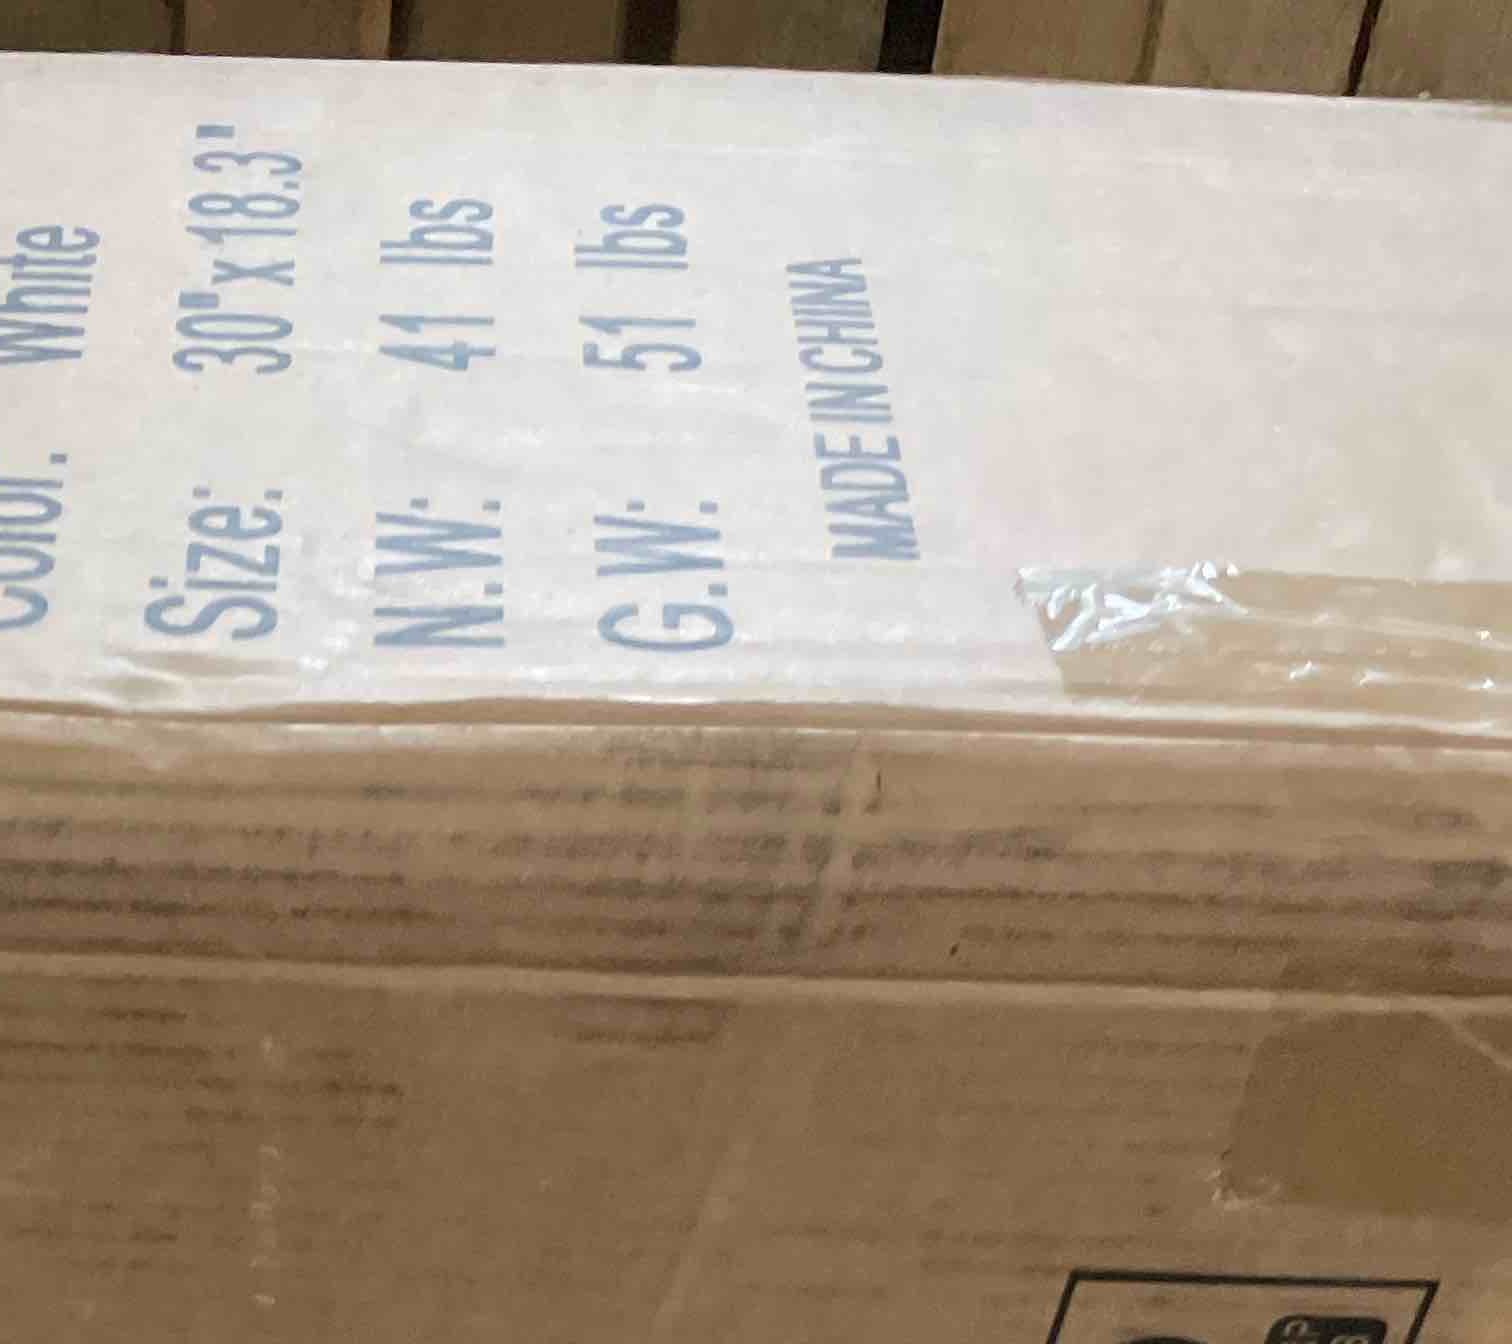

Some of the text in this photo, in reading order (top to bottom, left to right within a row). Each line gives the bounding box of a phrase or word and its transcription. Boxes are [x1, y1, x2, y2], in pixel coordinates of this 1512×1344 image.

[379, 198, 494, 265] lbs
[574, 203, 689, 270] lbs
[210, 258, 296, 286] x
[379, 313, 497, 372] 41
[579, 315, 703, 373] 51
[785, 256, 921, 561] MADE IN CHINA
[143, 488, 284, 641] Size:
